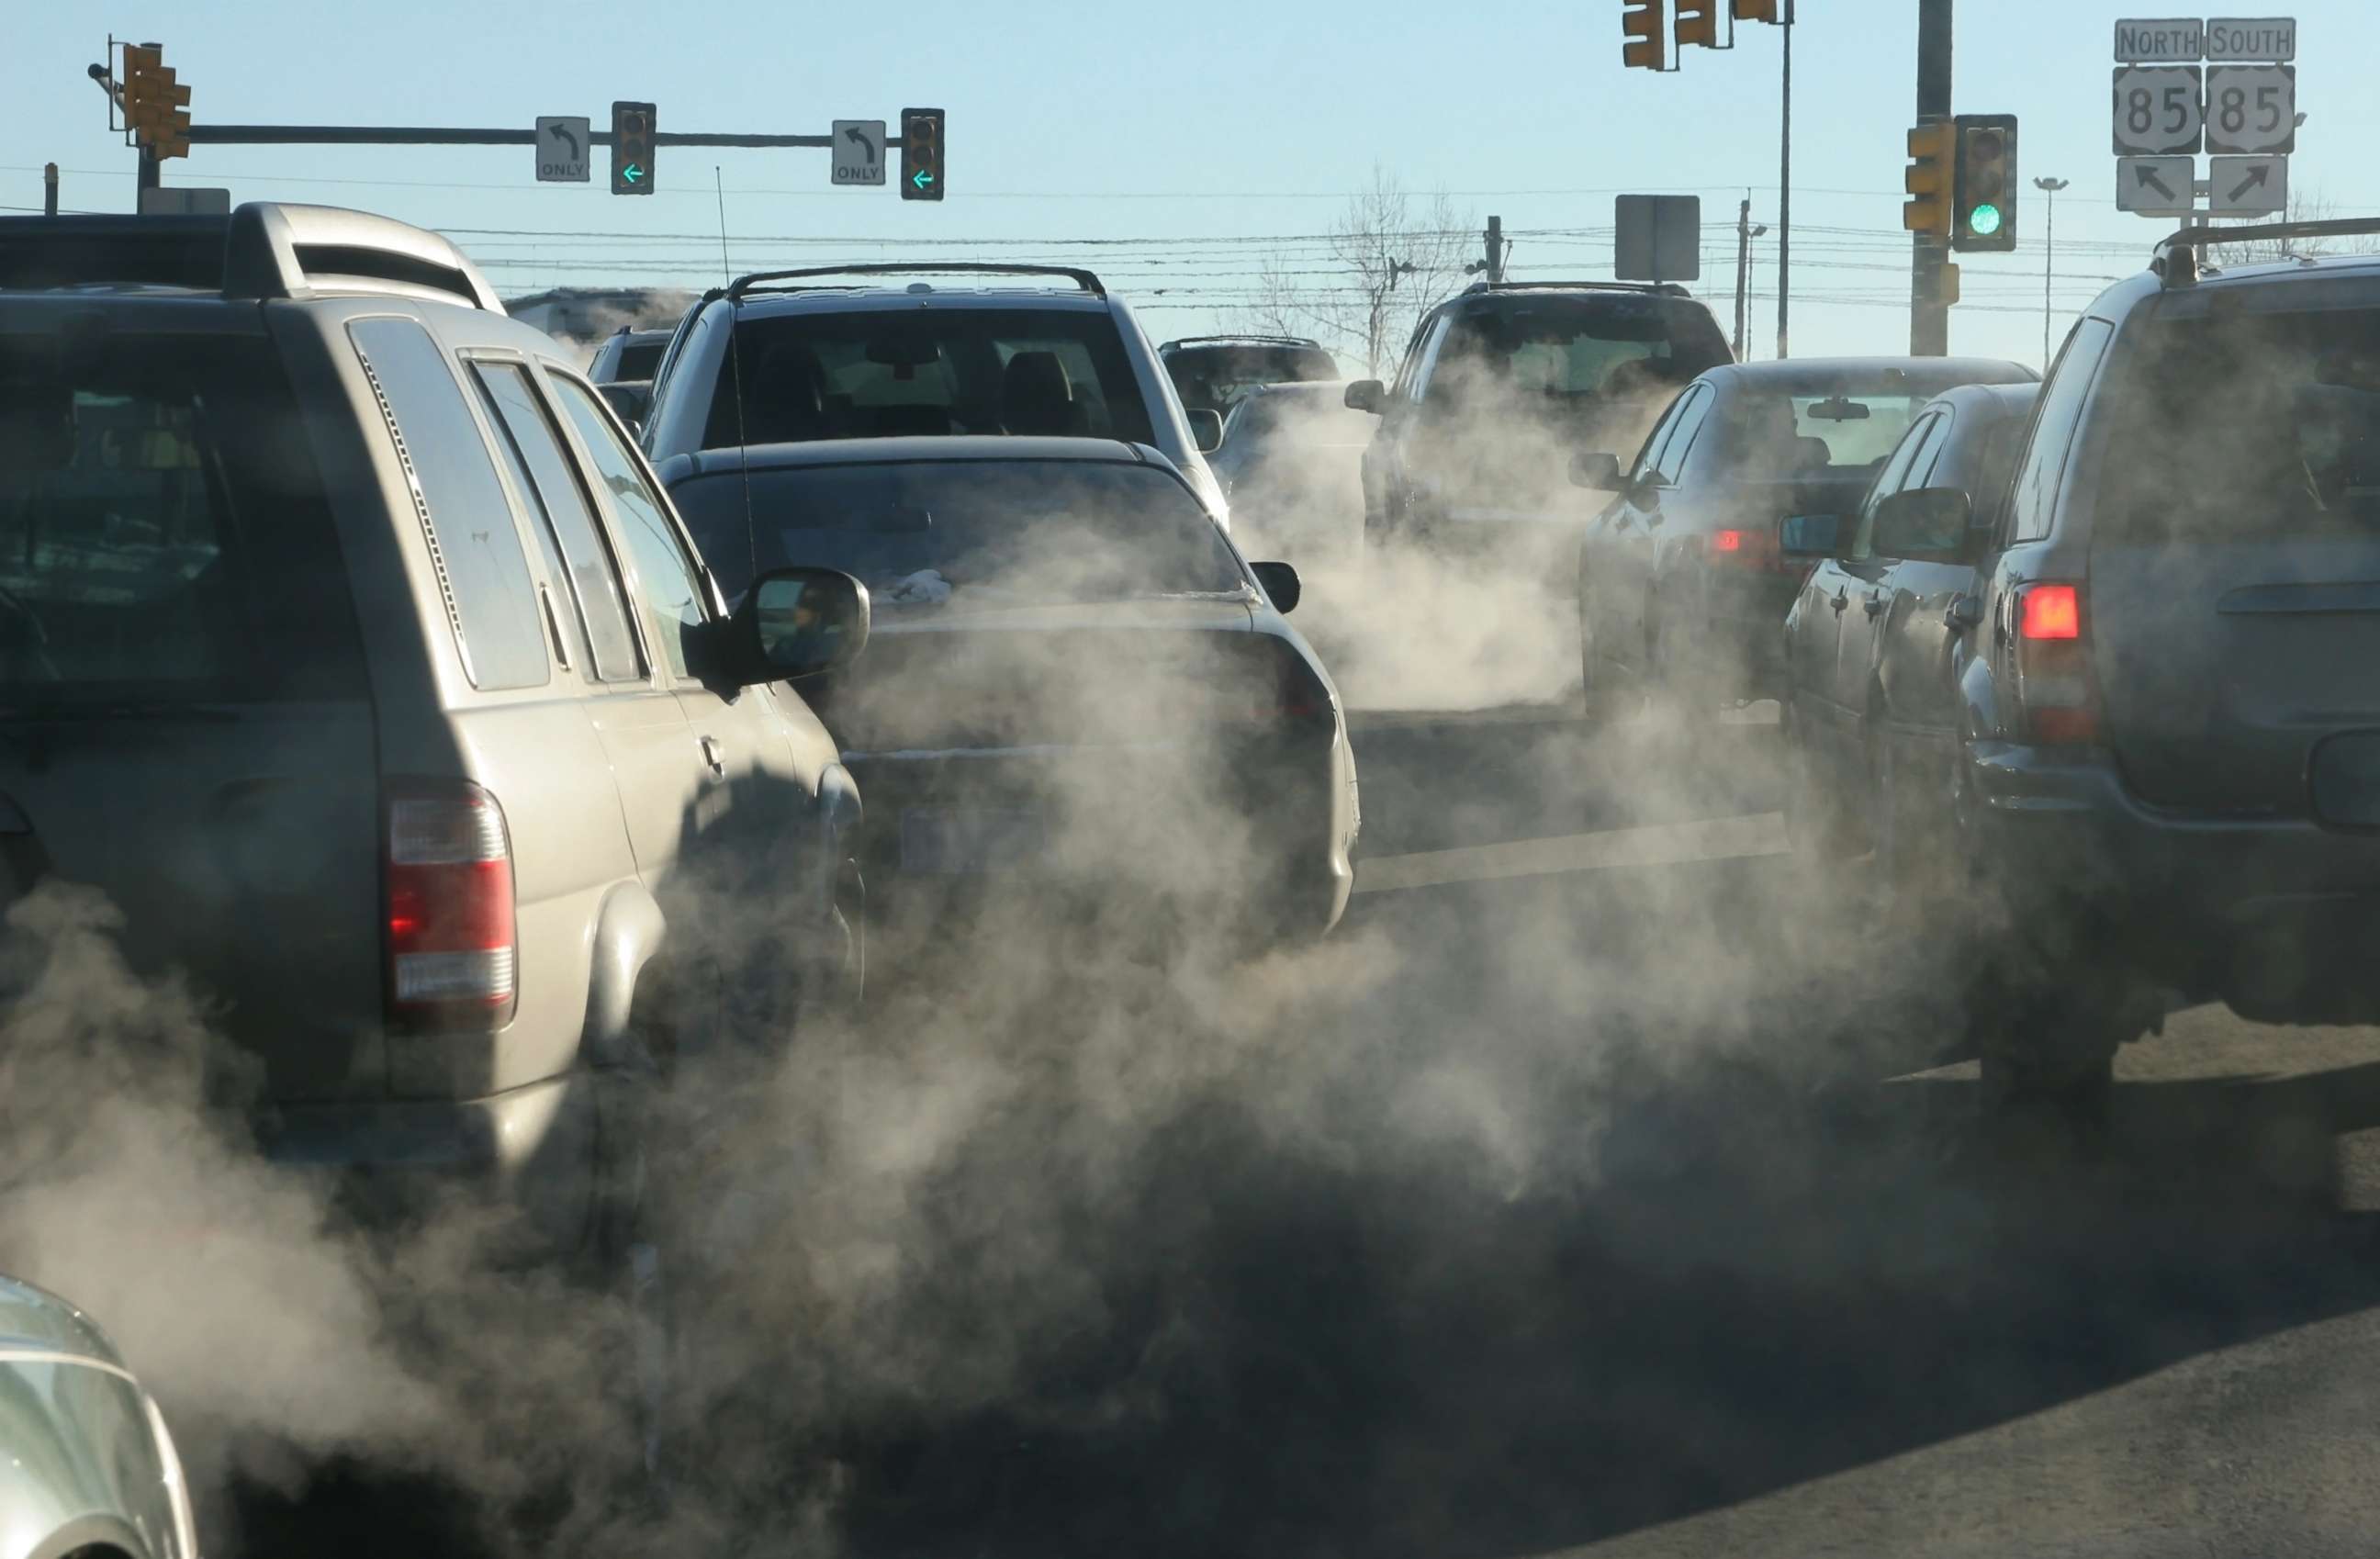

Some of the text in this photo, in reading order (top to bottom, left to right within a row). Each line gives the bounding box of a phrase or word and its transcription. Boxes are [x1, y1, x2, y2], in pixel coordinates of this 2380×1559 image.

[2120, 27, 2197, 54] NORTH
[2213, 26, 2290, 53] SOUTH
[2127, 87, 2187, 134] 85
[2220, 86, 2280, 133] 85
[543, 163, 584, 176] ONLY
[837, 166, 879, 180] ONLY
